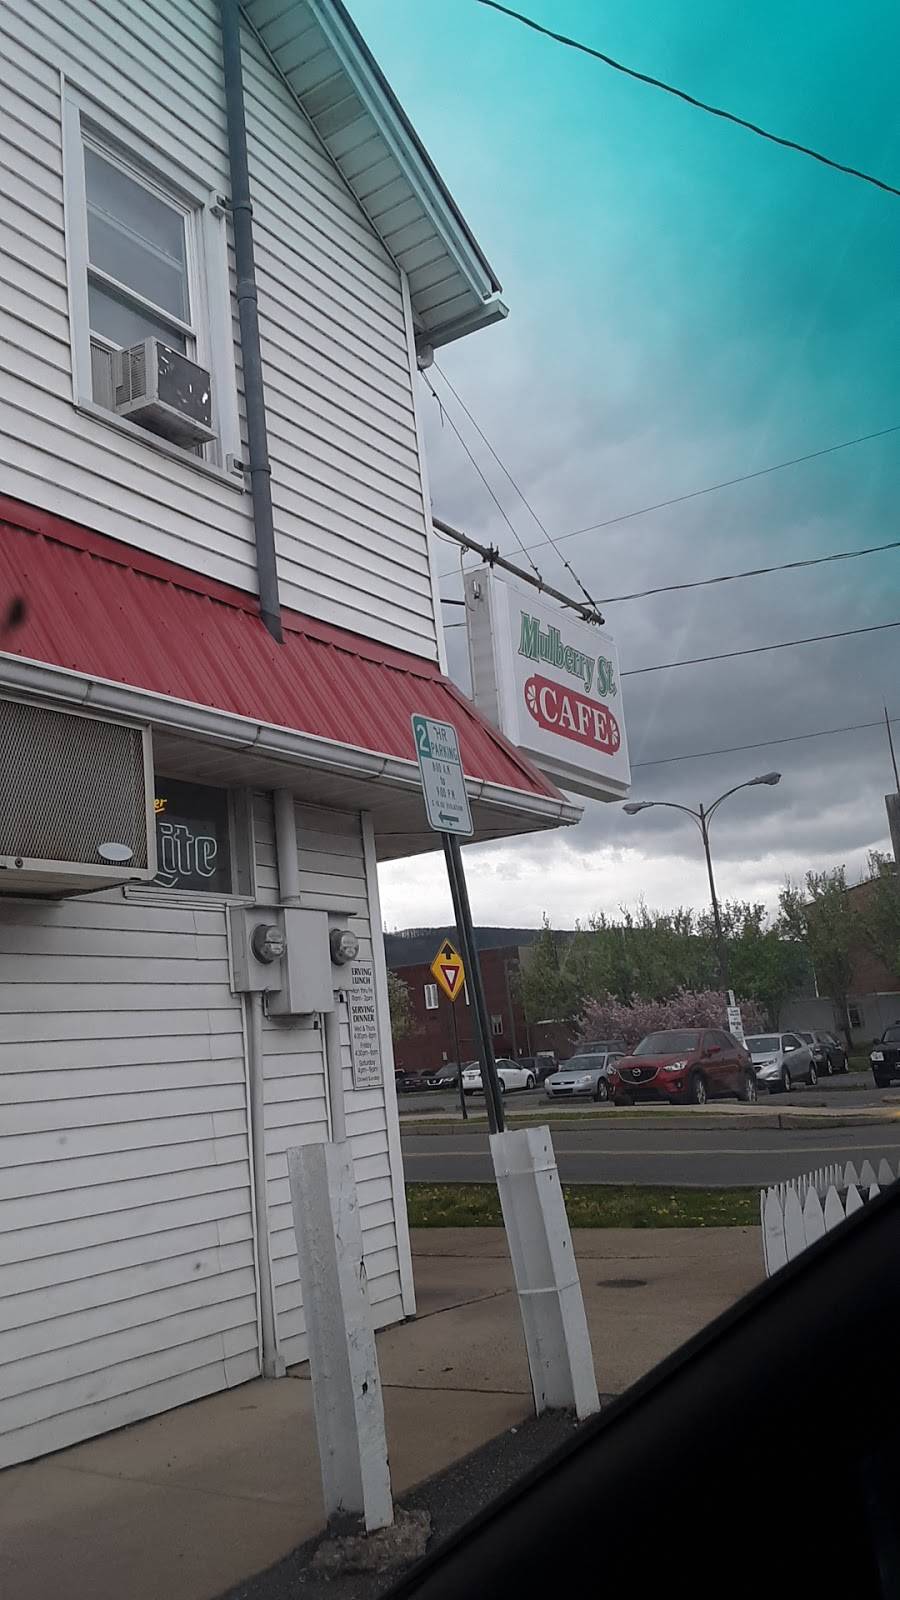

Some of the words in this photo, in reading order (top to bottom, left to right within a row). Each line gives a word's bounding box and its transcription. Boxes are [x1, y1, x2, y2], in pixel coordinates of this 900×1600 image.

[518, 611, 596, 693] Mulberry
[539, 687, 609, 744] CAFE
[416, 724, 430, 752] 2
[433, 727, 448, 742] HR
[430, 741, 458, 760] PARKING
[351, 967, 372, 976] ERVING
[352, 976, 371, 985] LUNCH
[351, 1006, 375, 1014] SERVING
[353, 1014, 375, 1023] DINNER
